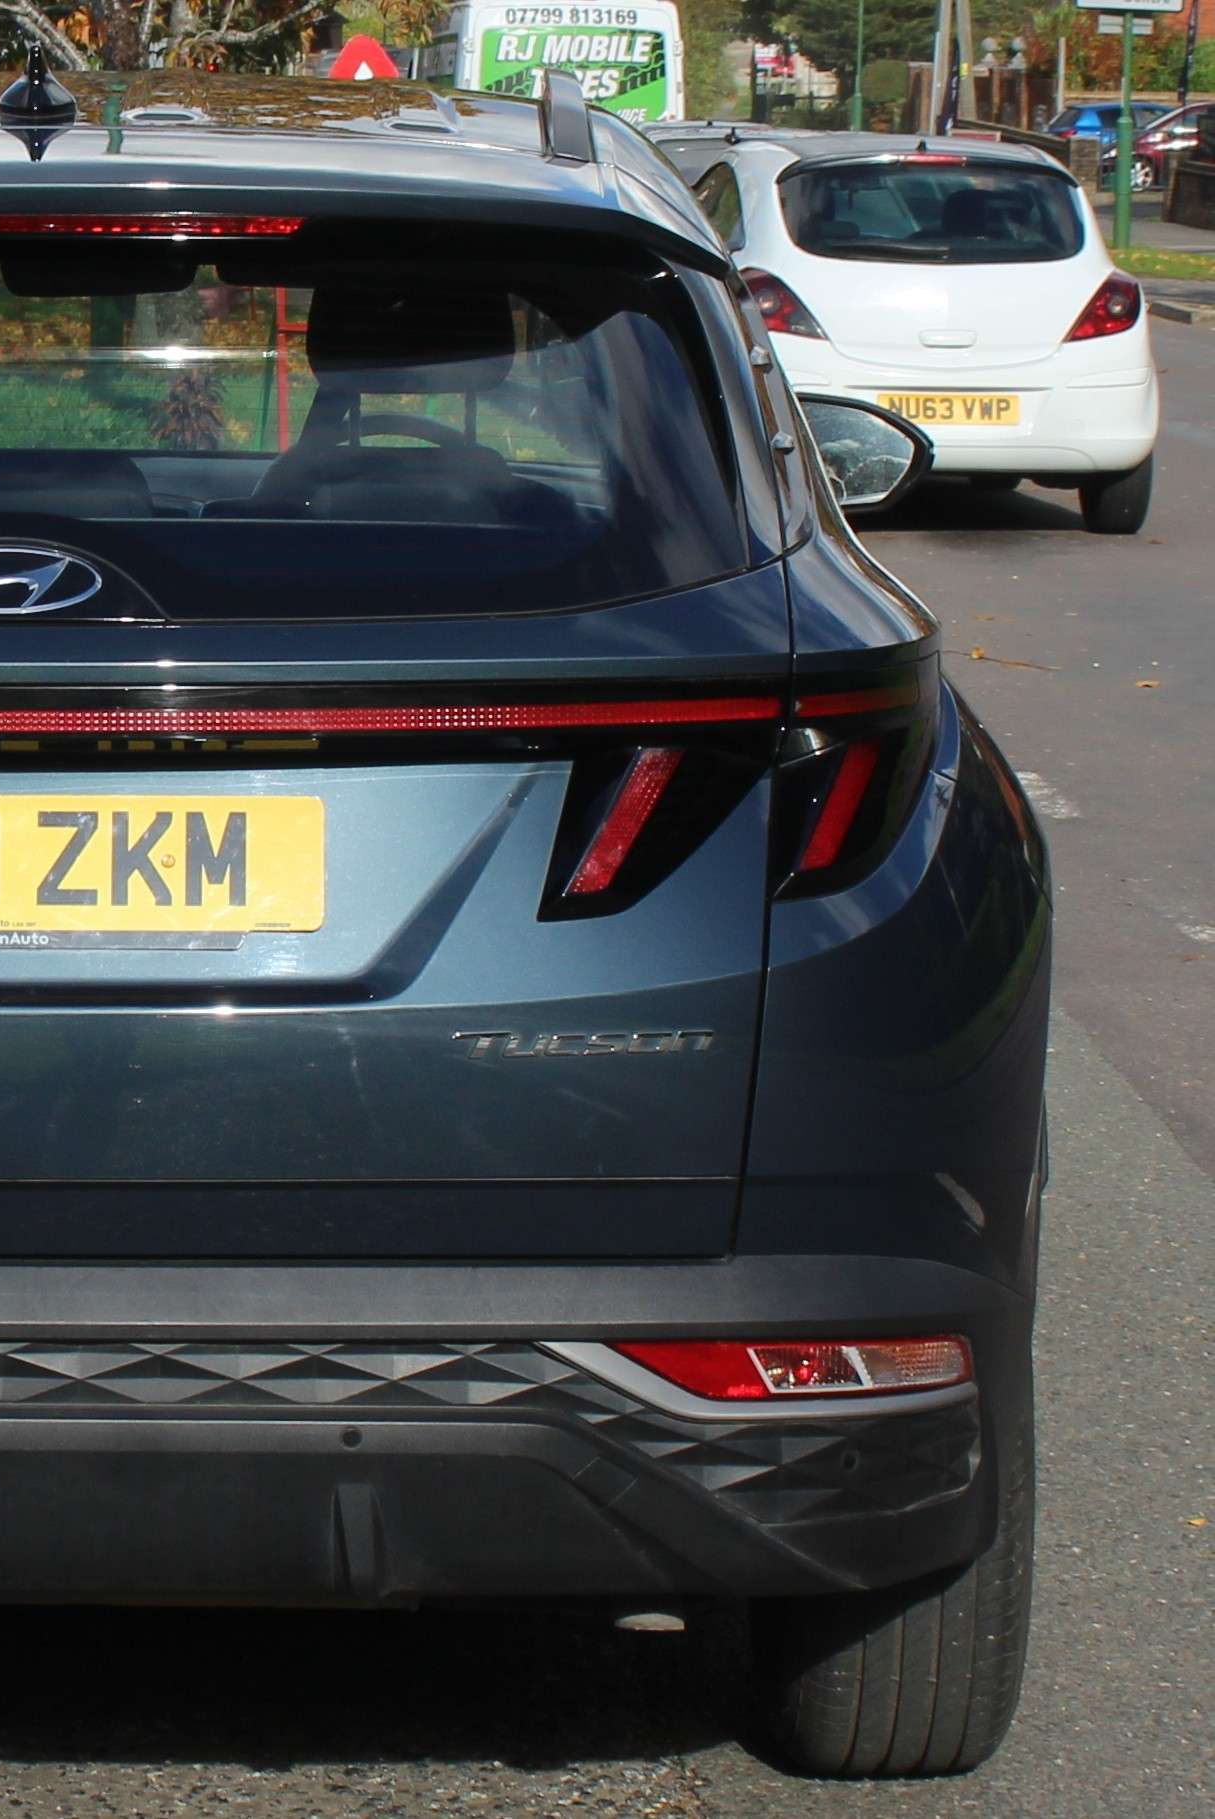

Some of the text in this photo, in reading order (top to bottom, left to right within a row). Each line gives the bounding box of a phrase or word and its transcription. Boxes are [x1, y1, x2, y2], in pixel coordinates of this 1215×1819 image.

[505, 8, 637, 25] 07799 813169
[497, 34, 654, 64] RJ MOBILE
[530, 68, 620, 99] TES
[889, 397, 1011, 421] NU63 VWP
[36, 811, 247, 907] ZKM
